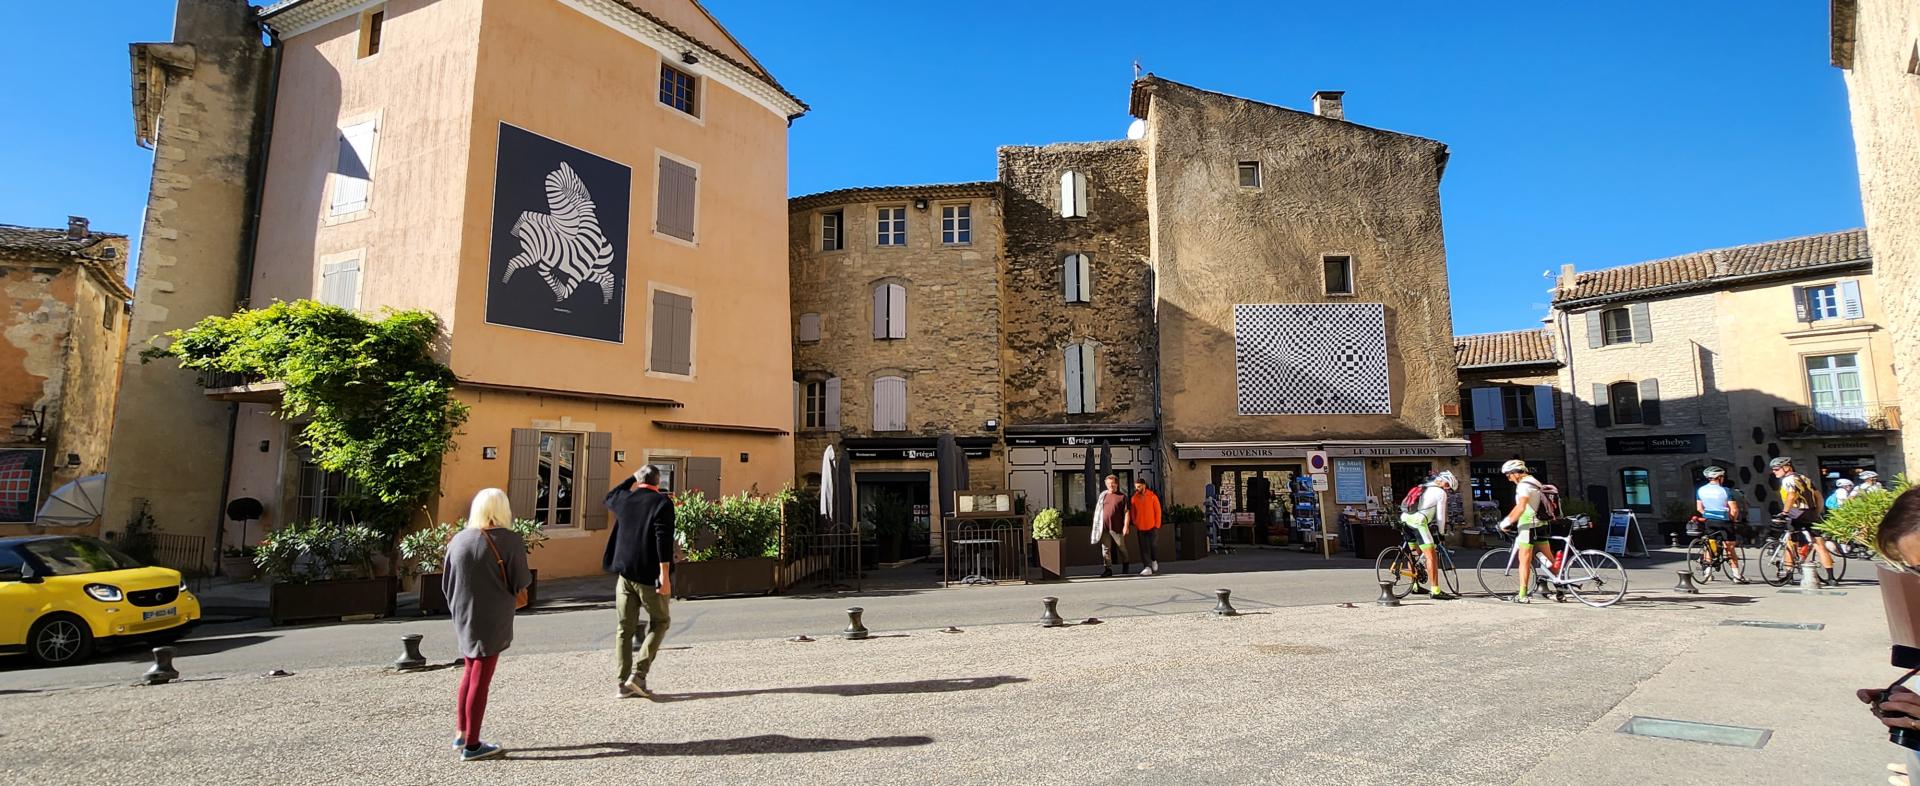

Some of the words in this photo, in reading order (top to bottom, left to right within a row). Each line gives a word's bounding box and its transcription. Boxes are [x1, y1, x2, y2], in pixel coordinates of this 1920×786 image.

[1062, 436, 1095, 445] L'Artégal
[1652, 438, 1692, 447] Sotheby's
[902, 450, 935, 459] L'Artégal
[1221, 449, 1273, 457] SOUVENIRS
[1399, 447, 1437, 455] PEYRON
